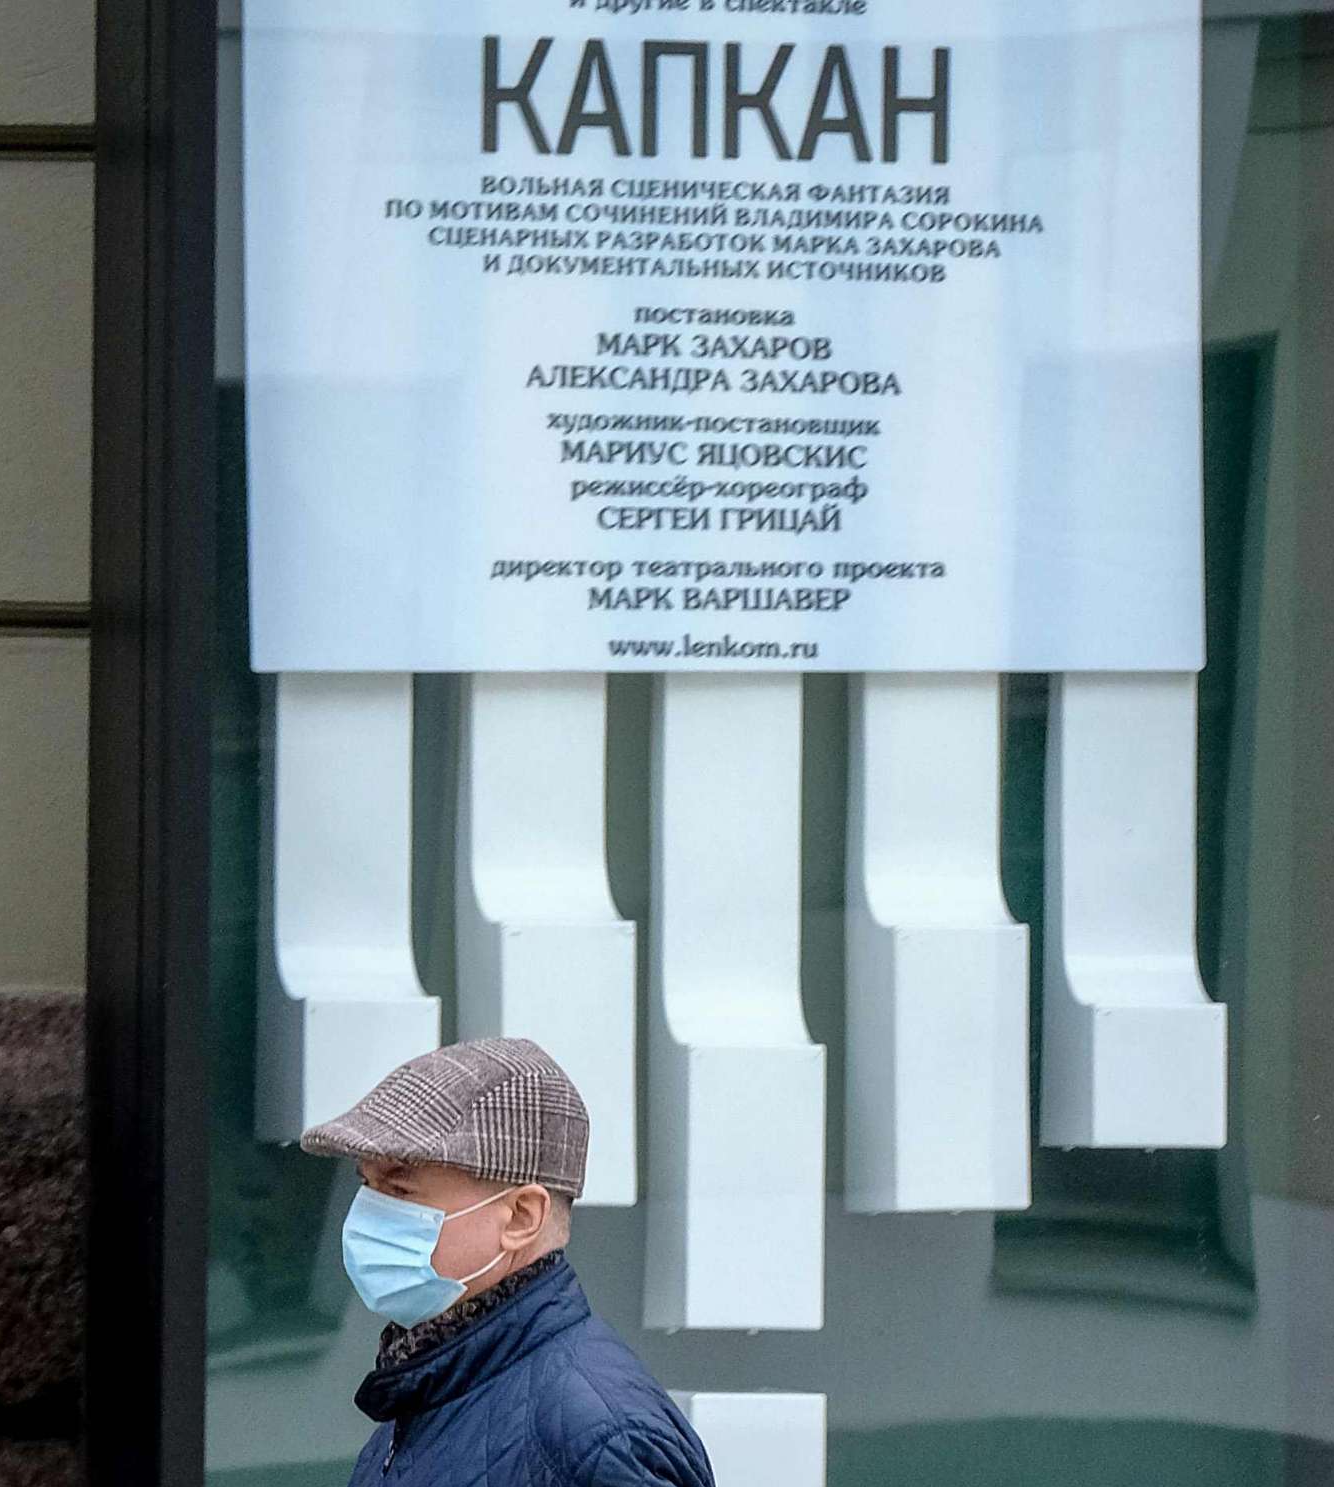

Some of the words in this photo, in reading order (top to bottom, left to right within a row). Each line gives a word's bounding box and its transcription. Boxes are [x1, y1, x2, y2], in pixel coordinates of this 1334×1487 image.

[724, 0, 867, 15] спектакле
[481, 35, 951, 165] КАПКАН
[481, 176, 604, 197] ВОЛЬНАЯ
[610, 179, 801, 202] СЦЕНИЧЕСКАЯ
[807, 184, 950, 205] ФАНТАЗИЯ
[385, 199, 424, 219] ПО
[429, 200, 558, 222] МОТИВАМ
[565, 203, 727, 226] СОЧИНЕНИЙ
[734, 208, 894, 231] ВЛАДИМИРА
[901, 212, 1043, 233] СОРОКИНА
[428, 226, 589, 249] СЦЕНАРНЫХ
[596, 231, 766, 252] РАЗРАБОТОК
[772, 235, 860, 255] МАРКА
[866, 237, 1001, 258] ЗАХАРОВА
[483, 254, 501, 272] И
[507, 254, 760, 279] ДОКУМЕНТАЛЬНЫХ
[767, 261, 946, 283] ИСТОЧНИКОВ
[634, 307, 795, 326] постановка
[597, 333, 681, 357] МАРК
[691, 335, 832, 360] ЗАХАРОВ
[526, 365, 731, 394] АЛЕКСАНДРА
[740, 369, 902, 396] ЗАХАРОВА
[547, 413, 881, 438] художник-постановщик
[561, 440, 687, 465] МАРИУС
[697, 443, 867, 470] ЯЦОВСКИС
[720, 503, 841, 535] ГРИЦАЙ
[491, 560, 623, 582] директор
[631, 561, 824, 582] театрального
[833, 562, 945, 583] проекта
[588, 587, 673, 610] МАРК
[683, 588, 851, 611] ВАРШАВЕР
[608, 634, 818, 659] www.lenkom.ru
